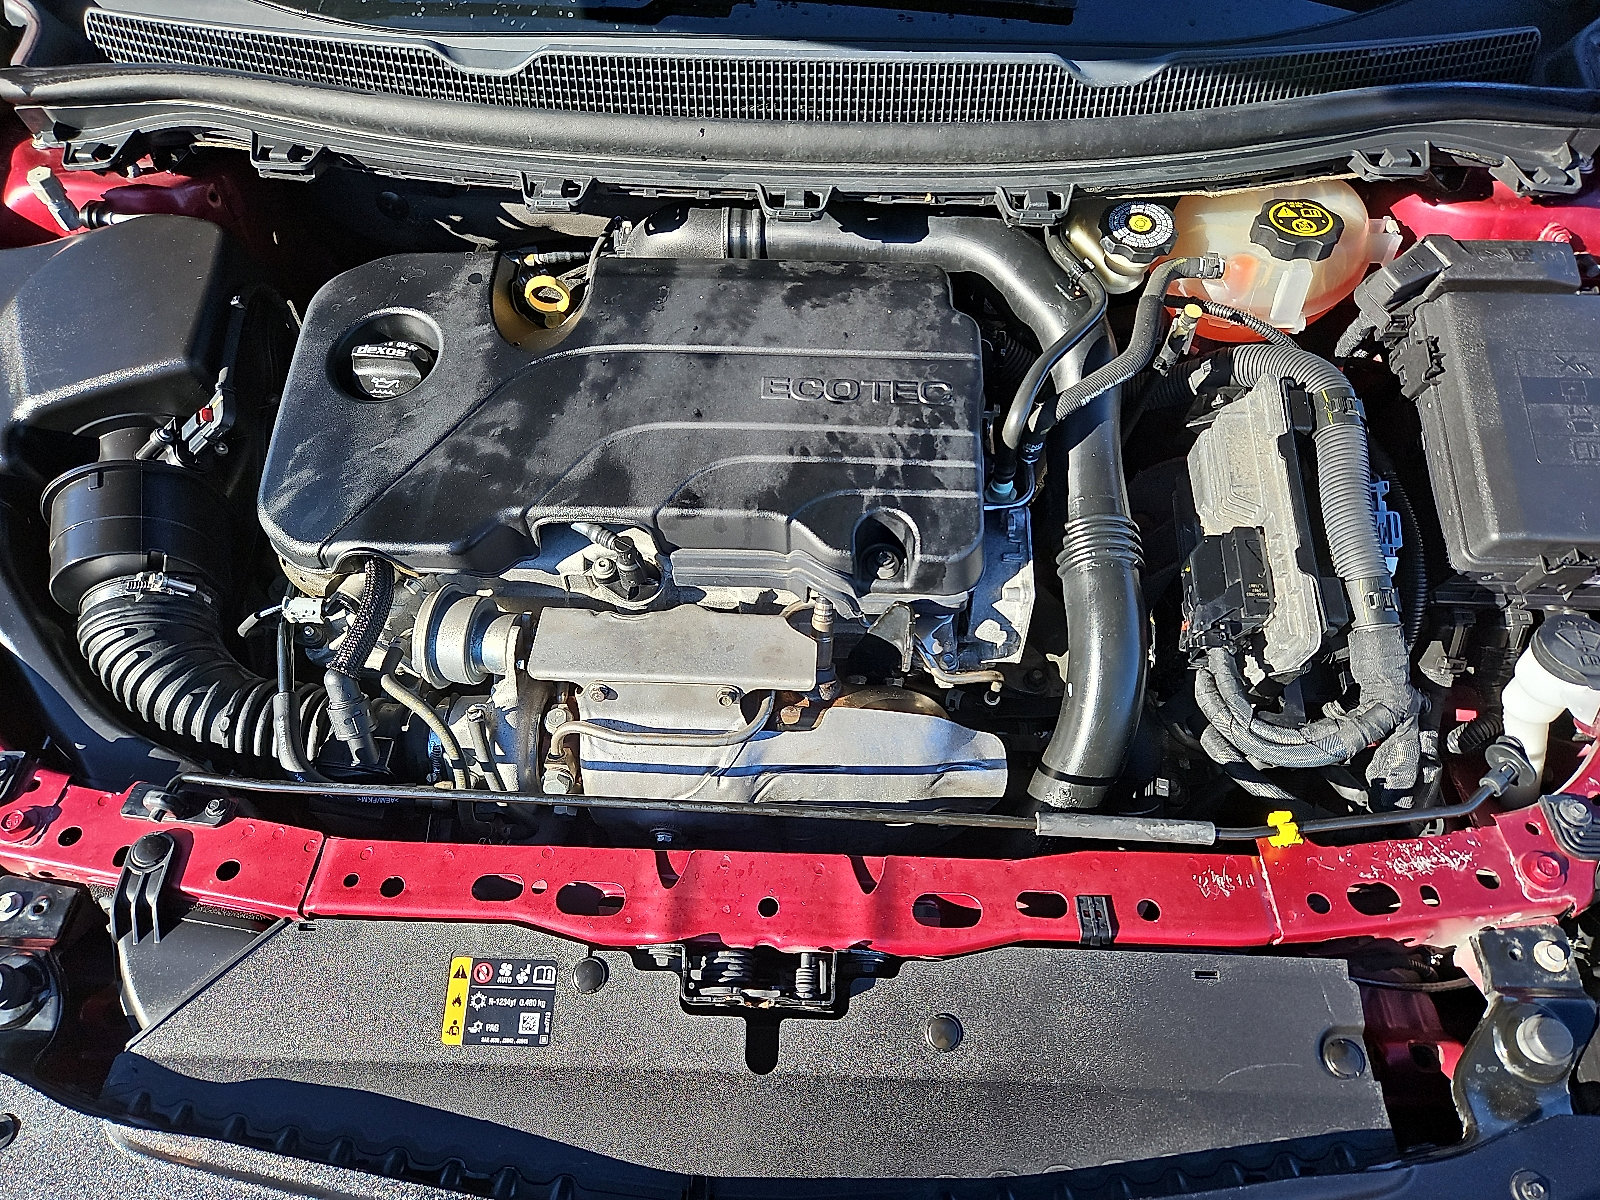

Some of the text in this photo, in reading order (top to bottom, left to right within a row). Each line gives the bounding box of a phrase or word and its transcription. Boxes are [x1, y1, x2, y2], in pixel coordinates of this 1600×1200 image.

[357, 345, 407, 357] dexos
[761, 376, 953, 404] ECOTEC
[488, 997, 516, 1007] R-1234yf
[537, 998, 546, 1008] kg
[485, 1023, 500, 1033] PAG
